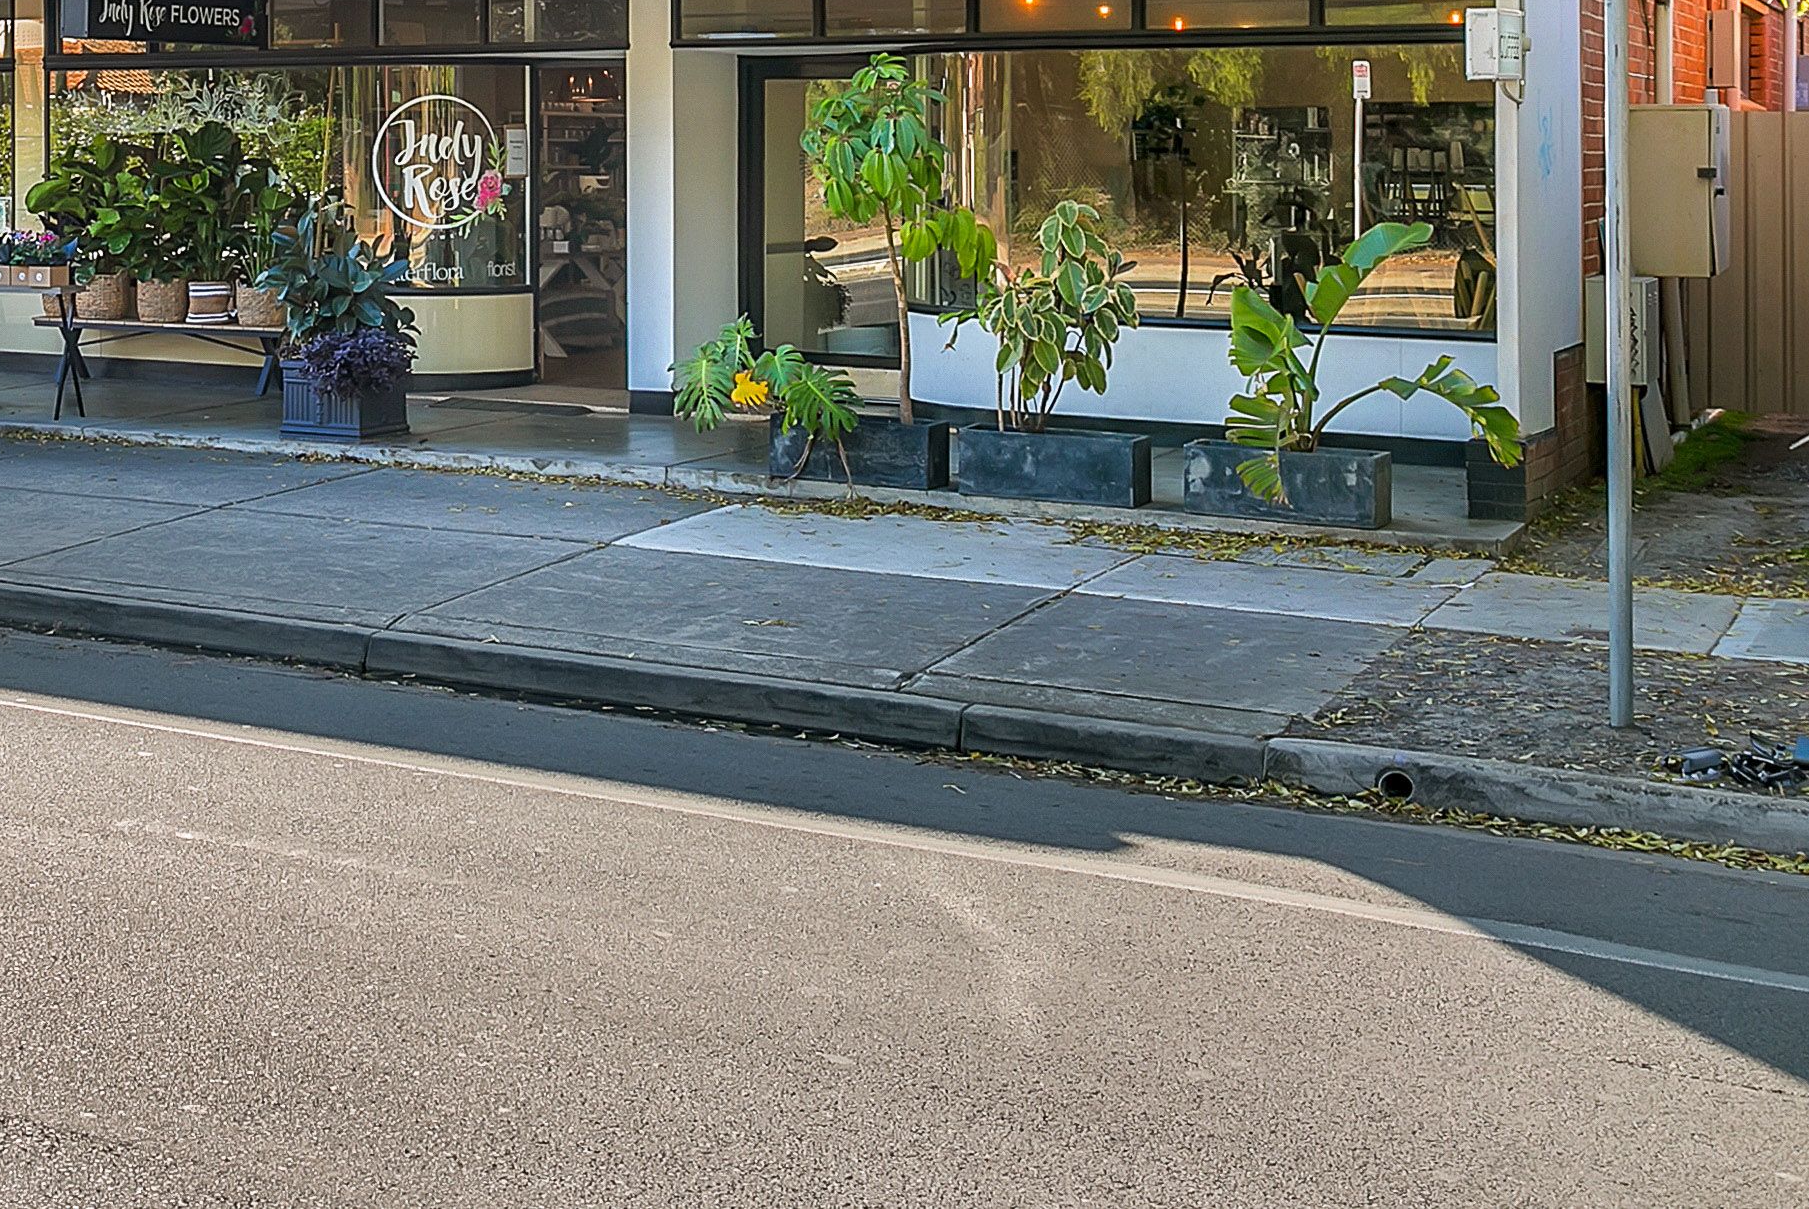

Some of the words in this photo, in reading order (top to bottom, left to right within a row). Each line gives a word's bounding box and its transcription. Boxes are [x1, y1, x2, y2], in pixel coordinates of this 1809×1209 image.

[171, 4, 240, 27] FLOWERS
[390, 120, 482, 182] Indy
[402, 164, 476, 219] Rose
[487, 261, 516, 277] florist
